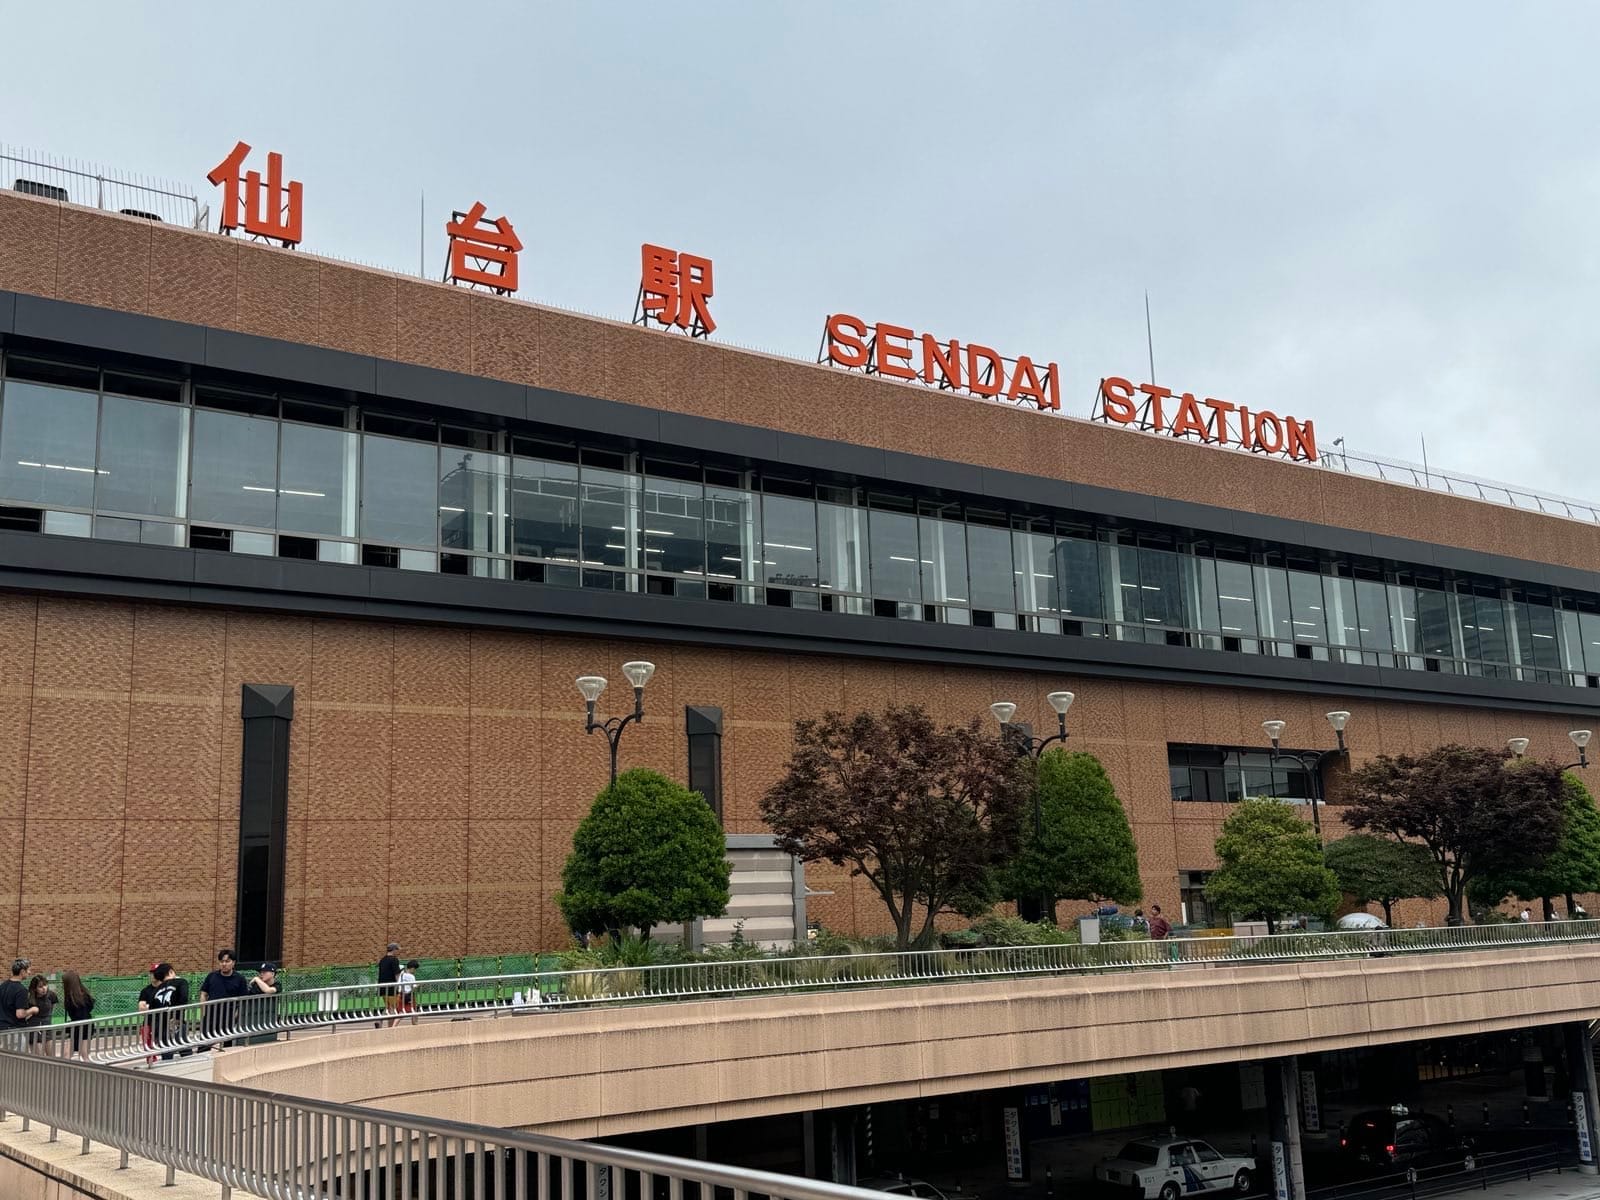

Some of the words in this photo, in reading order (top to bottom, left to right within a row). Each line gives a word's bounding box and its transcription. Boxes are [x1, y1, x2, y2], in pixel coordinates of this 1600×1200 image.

[206, 141, 717, 334] 仙台駅
[828, 313, 1060, 410] SENDAI
[1103, 376, 1317, 462] STATION
